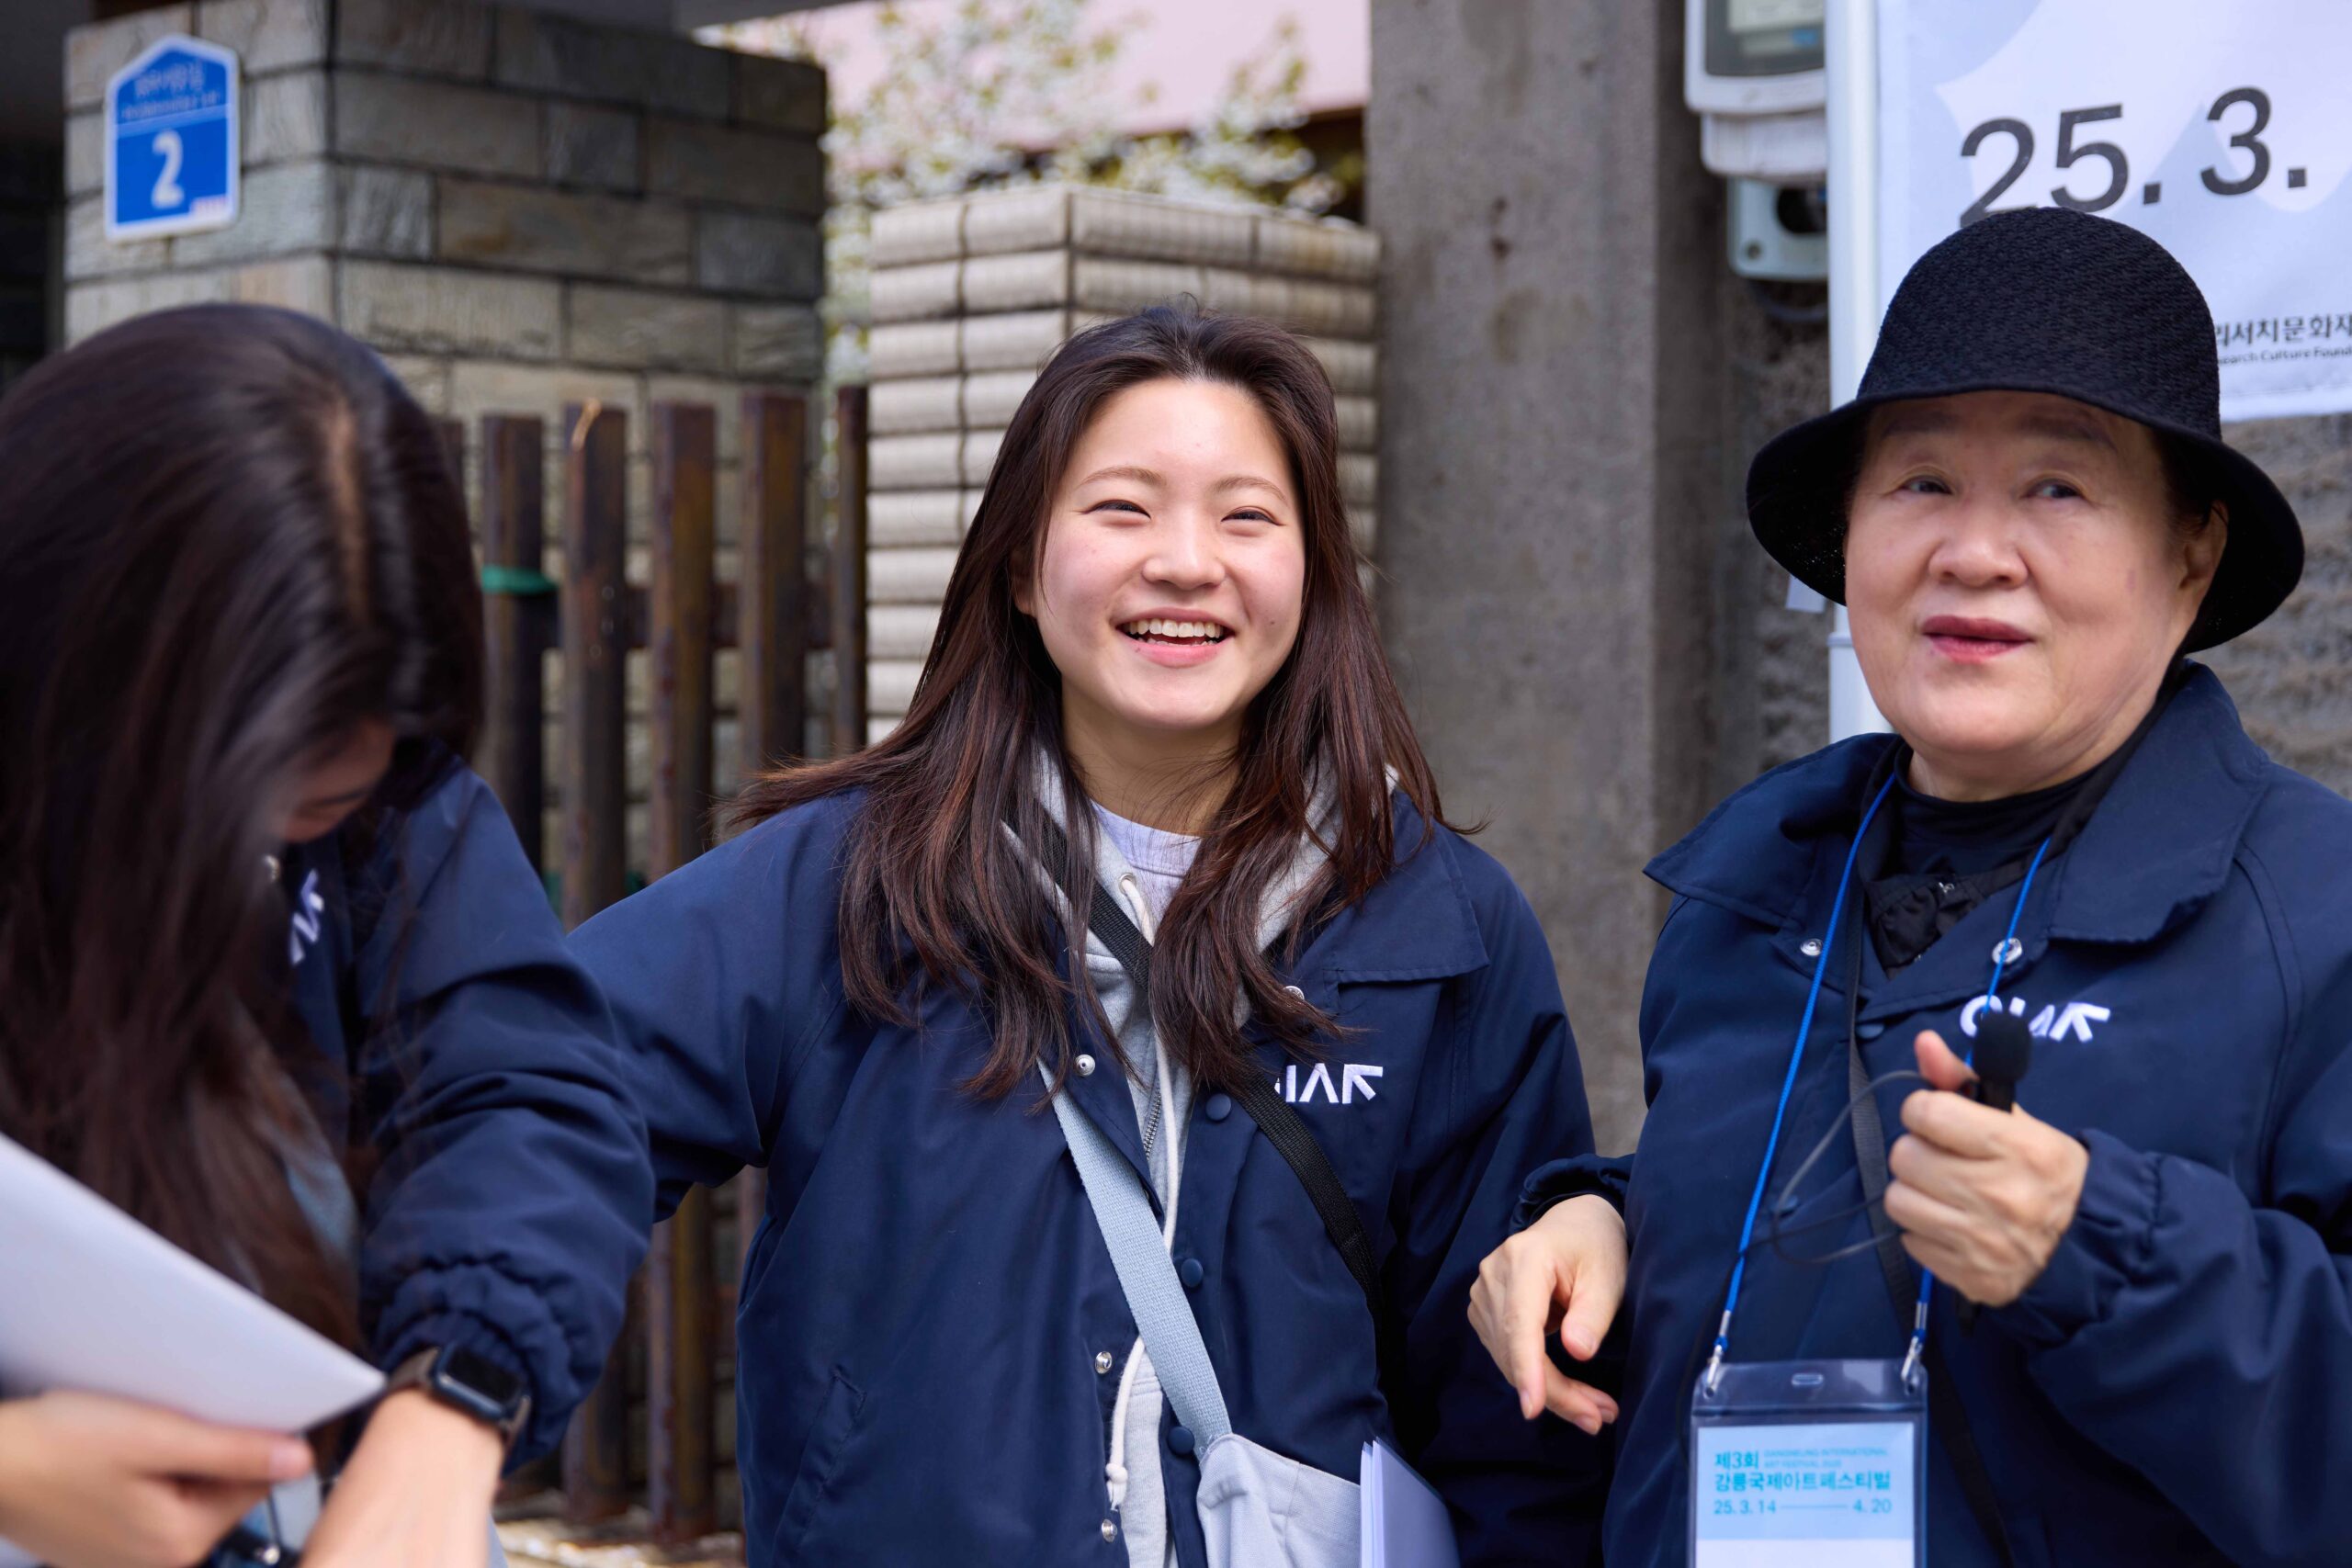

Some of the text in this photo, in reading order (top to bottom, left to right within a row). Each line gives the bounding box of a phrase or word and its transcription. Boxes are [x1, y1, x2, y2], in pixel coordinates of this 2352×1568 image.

[151, 127, 185, 210] 2
[2313, 344, 2352, 358] Found
[1713, 1450, 1759, 1470] 제3회
